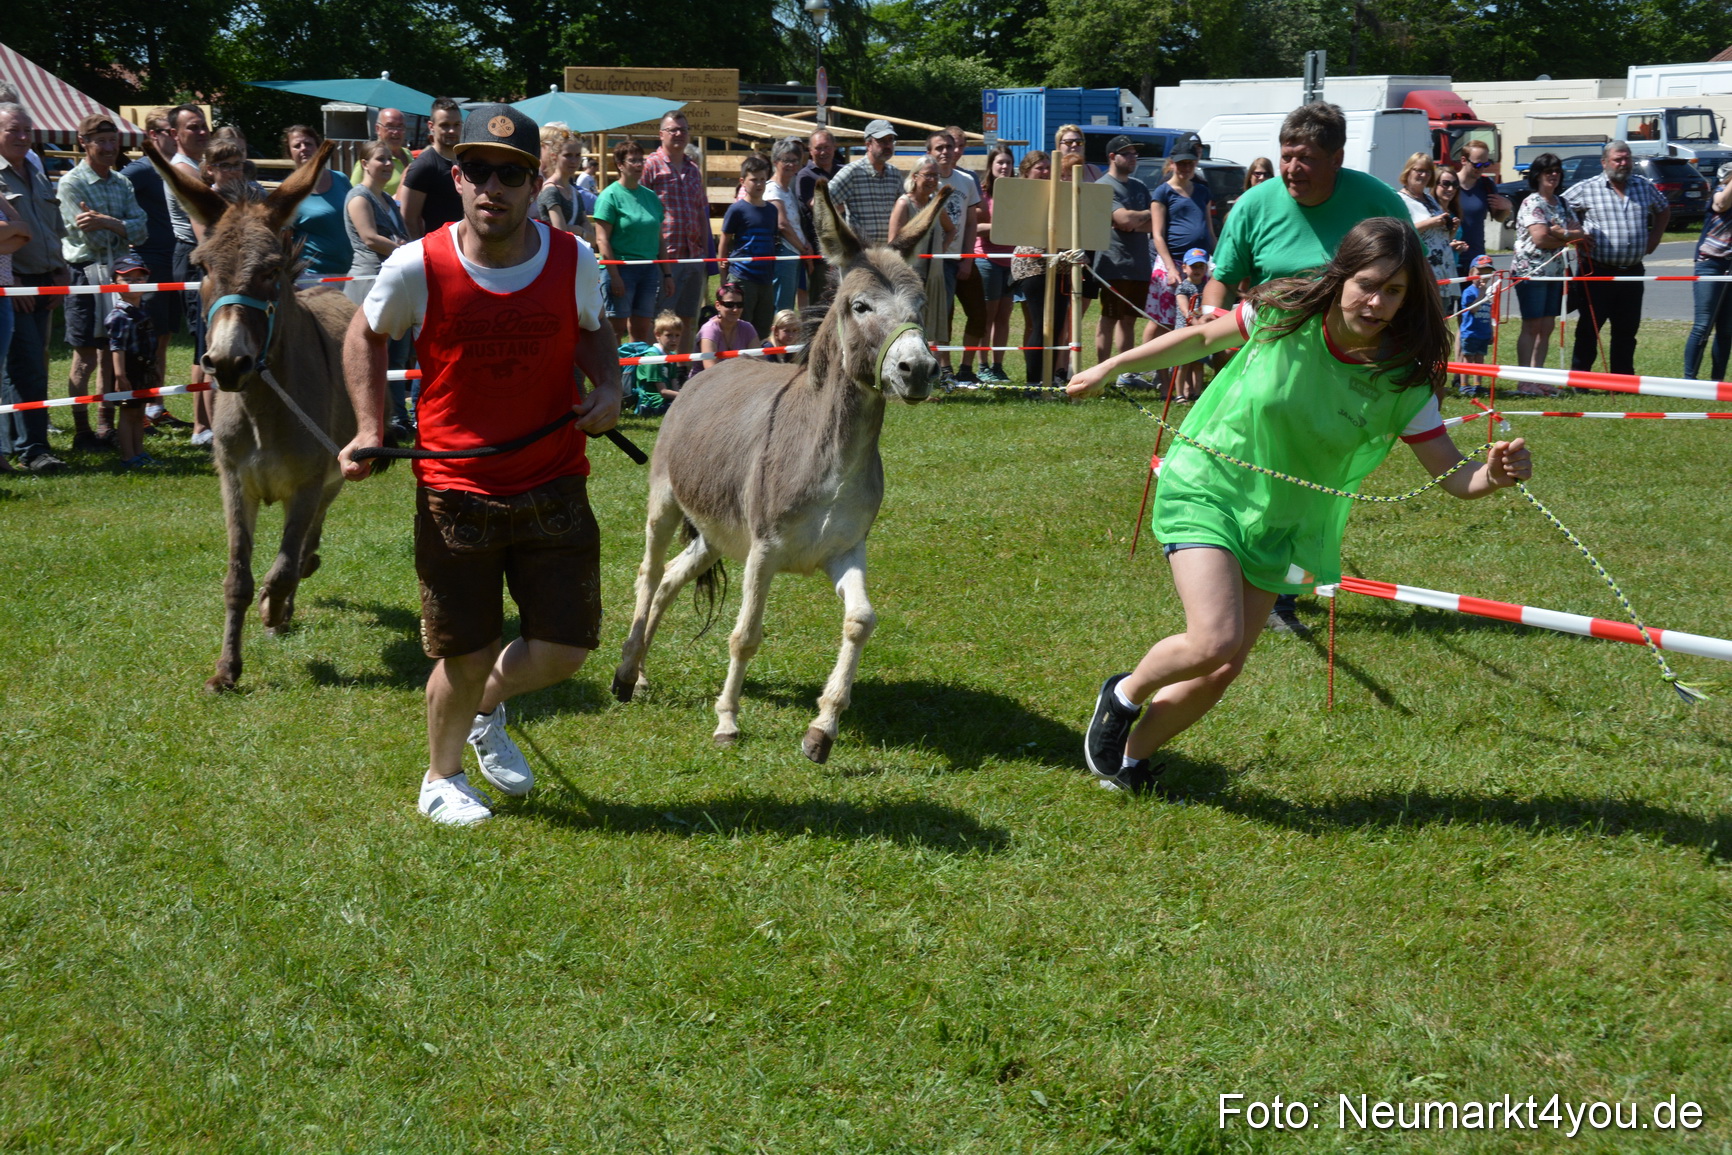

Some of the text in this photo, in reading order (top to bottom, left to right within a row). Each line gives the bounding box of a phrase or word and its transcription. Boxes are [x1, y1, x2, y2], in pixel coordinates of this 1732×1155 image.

[573, 73, 675, 96] Stauferbergesel
[985, 92, 995, 110] P
[985, 117, 996, 128] P2
[492, 309, 561, 334] Denim
[463, 341, 541, 359] MUSTANG
[1337, 408, 1359, 427] JAKO
